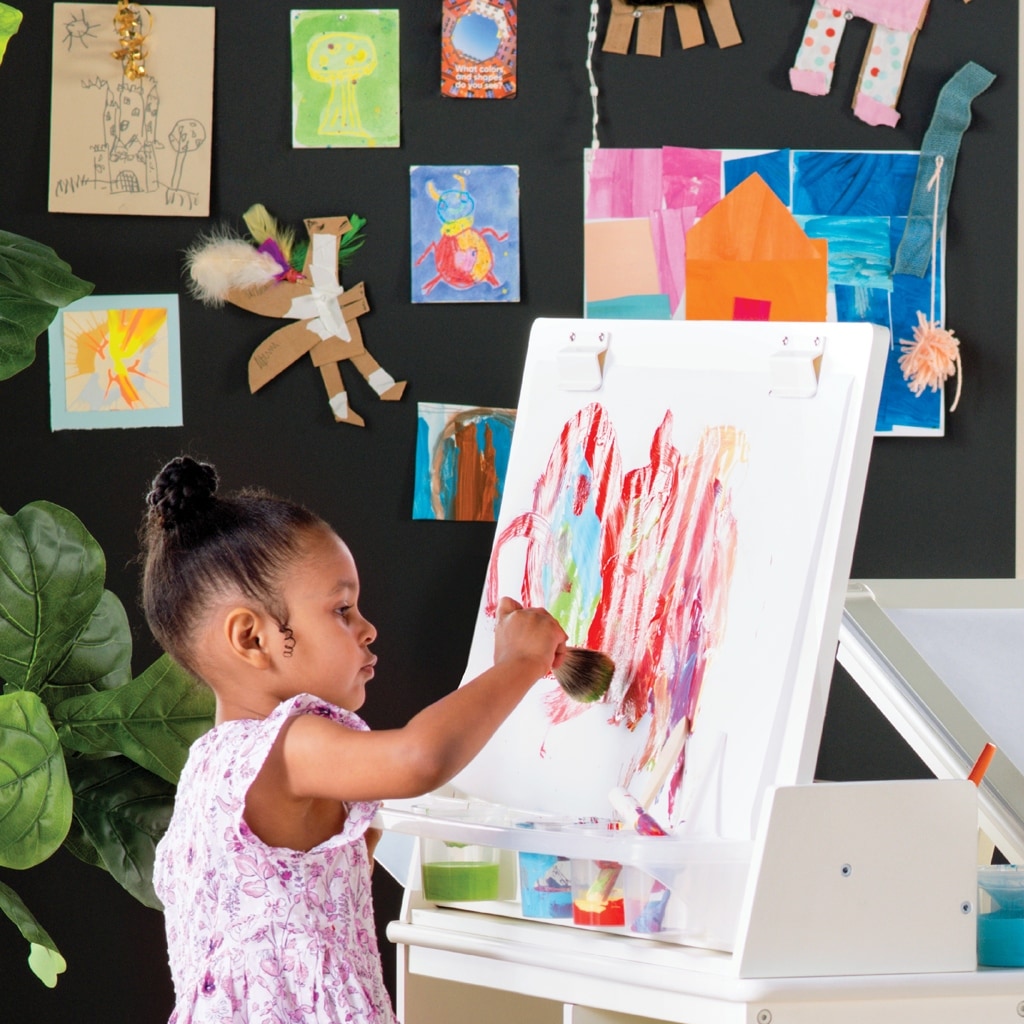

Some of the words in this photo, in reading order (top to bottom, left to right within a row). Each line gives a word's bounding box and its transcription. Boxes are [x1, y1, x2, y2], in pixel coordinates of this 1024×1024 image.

[455, 65, 477, 73] What
[479, 65, 504, 73] colors
[473, 73, 503, 82] shapes
[455, 81, 466, 89] do
[467, 82, 483, 90] you
